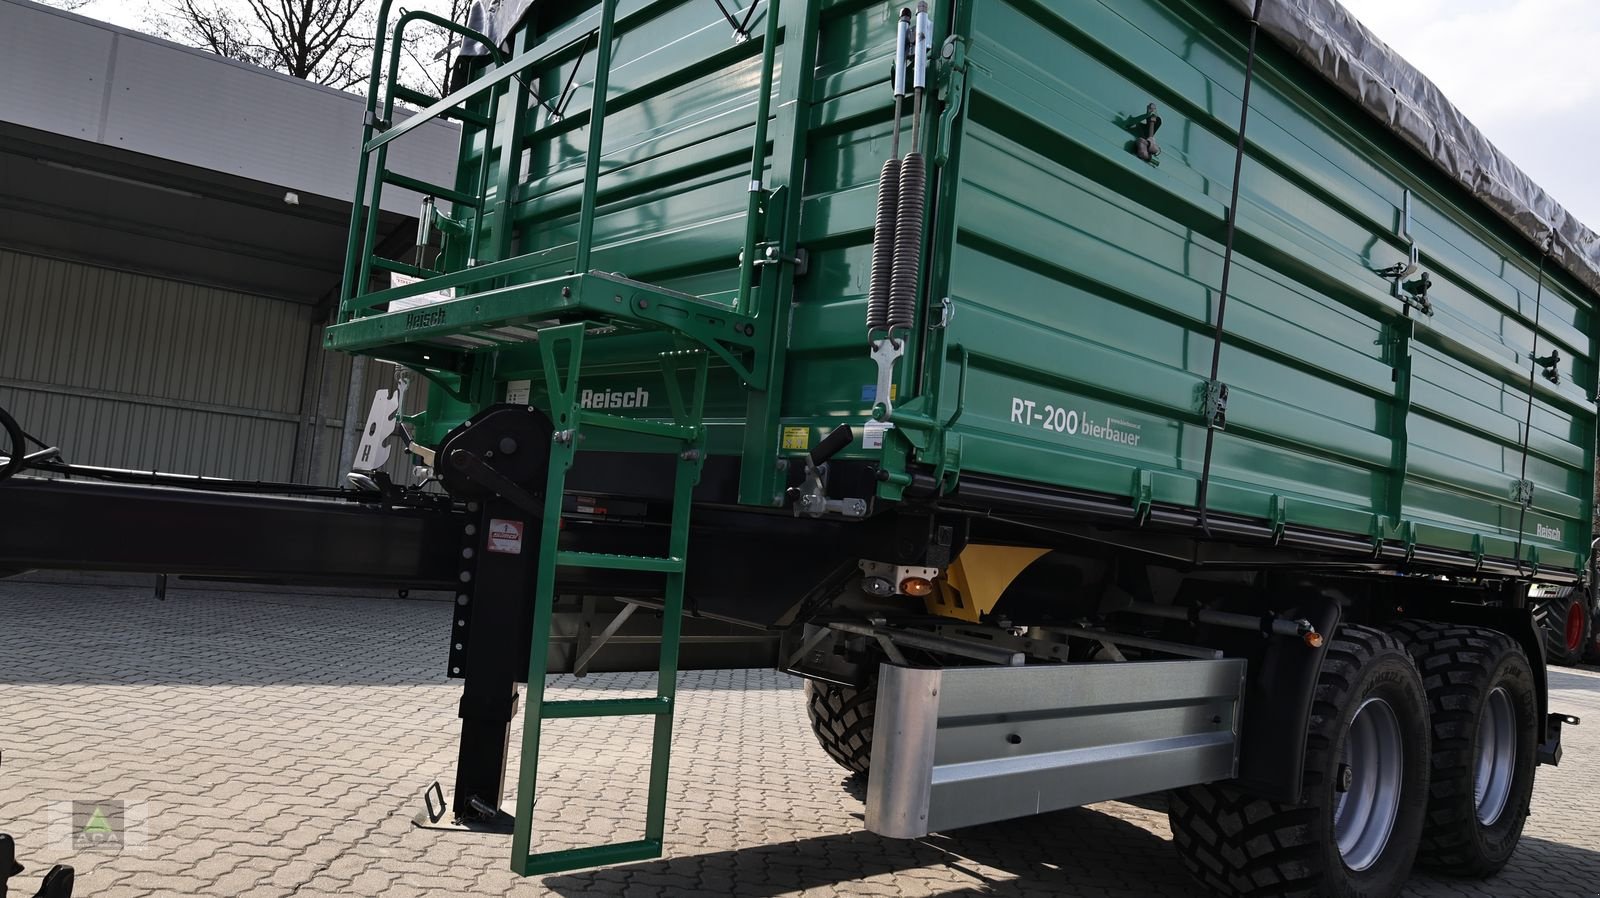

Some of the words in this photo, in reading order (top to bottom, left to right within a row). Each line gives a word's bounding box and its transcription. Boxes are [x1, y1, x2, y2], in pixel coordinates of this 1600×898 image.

[581, 387, 649, 409] Reisch
[1010, 397, 1078, 435] RT-200
[1081, 411, 1141, 447] bierbauer
[1536, 523, 1561, 541] Reisch
